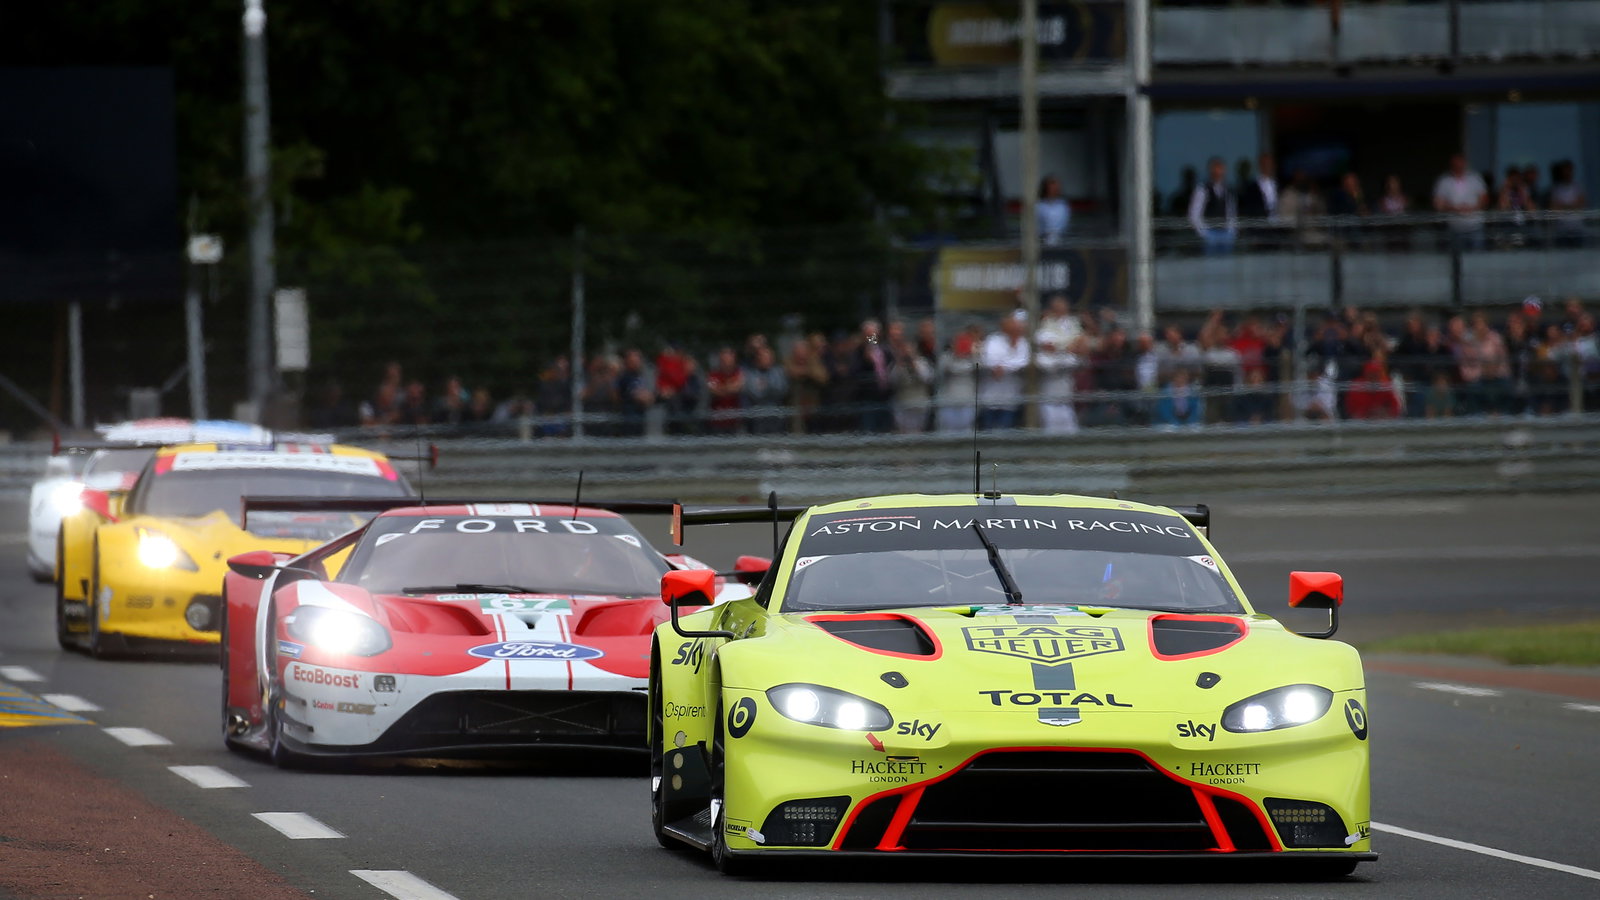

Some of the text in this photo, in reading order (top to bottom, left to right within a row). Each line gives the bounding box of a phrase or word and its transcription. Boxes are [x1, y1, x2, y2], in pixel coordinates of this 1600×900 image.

[409, 519, 599, 534] FORD
[811, 518, 1191, 538] ASTON MARTIN RACING
[490, 598, 558, 610] 67
[977, 627, 1105, 637] TAG
[494, 642, 577, 658] Ford
[671, 637, 704, 675] sky
[979, 639, 1112, 658] HEUER
[293, 665, 360, 689] EcoBoost
[978, 690, 1133, 707] TOTAL
[896, 719, 942, 741] sky
[1176, 720, 1217, 742] sky
[851, 760, 927, 774] HACKETT
[1190, 763, 1261, 776] HACKETT
[1209, 777, 1245, 785] LONDON
